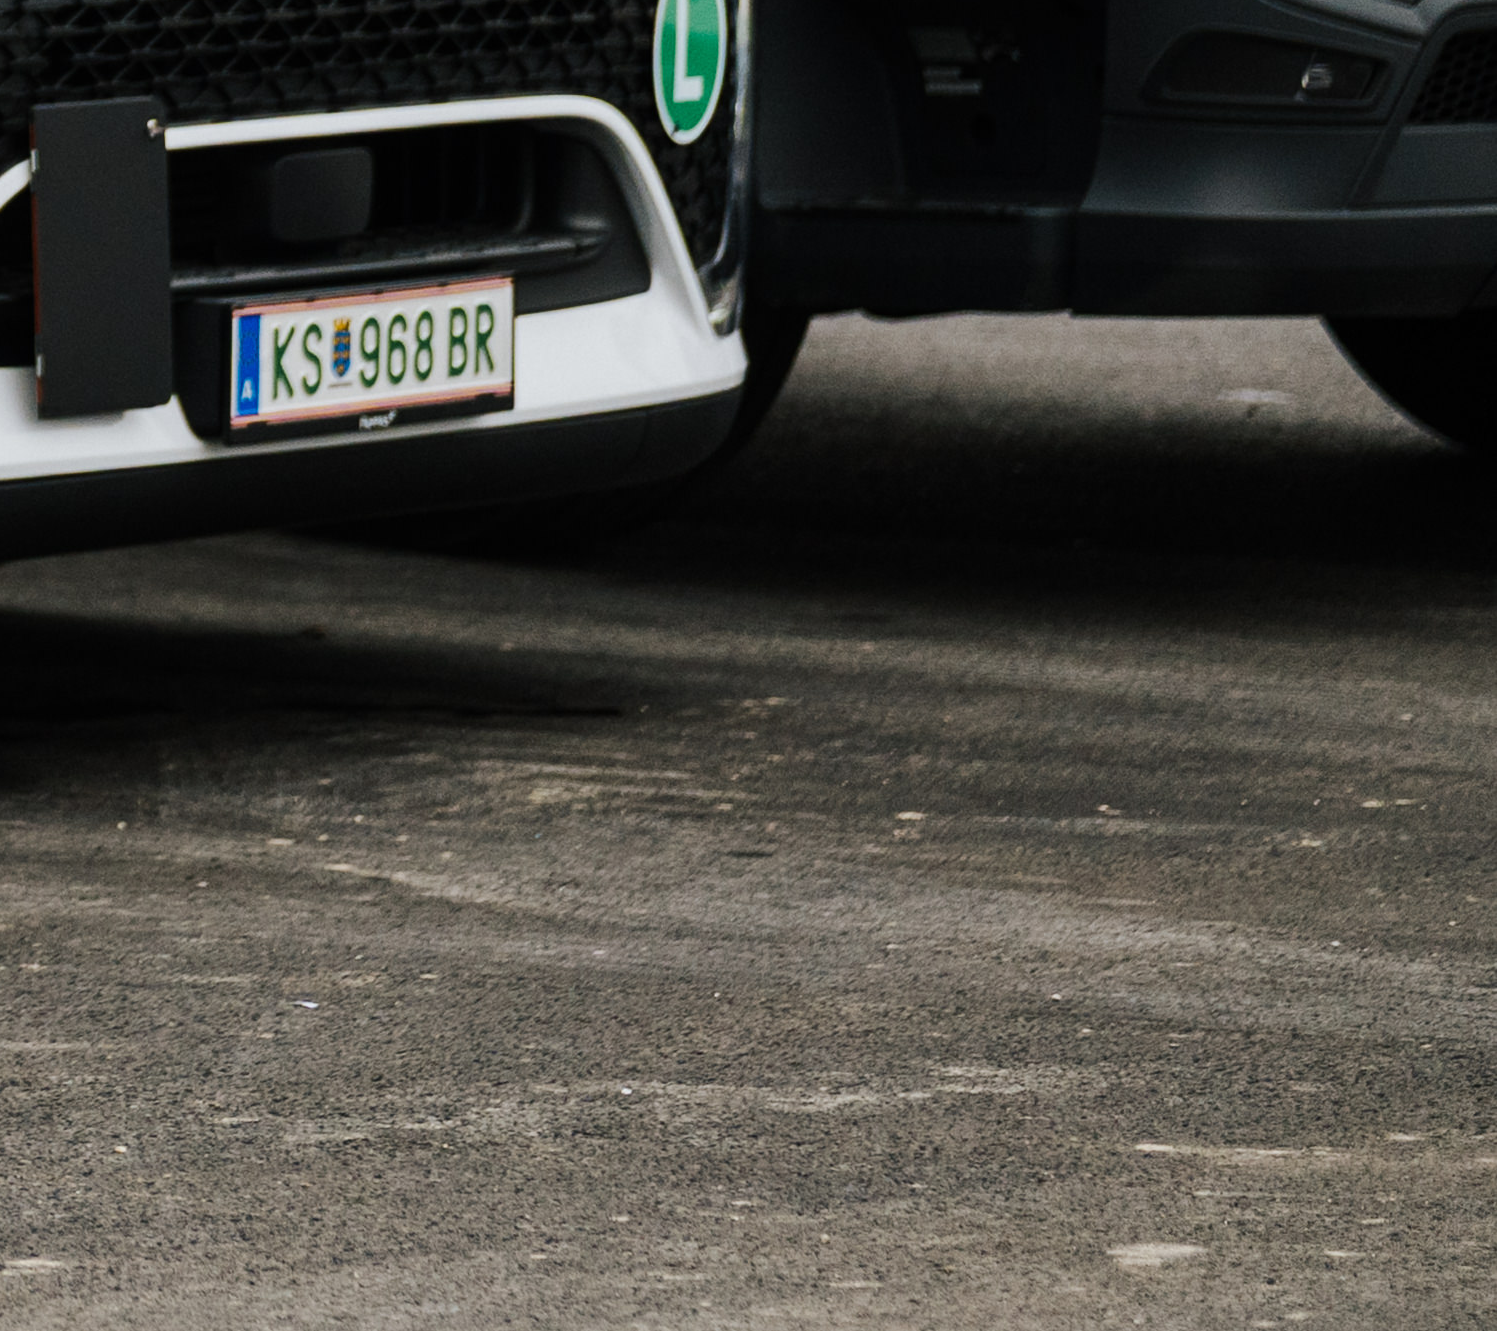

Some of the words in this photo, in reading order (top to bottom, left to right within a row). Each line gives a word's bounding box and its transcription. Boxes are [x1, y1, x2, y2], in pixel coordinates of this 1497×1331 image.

[272, 322, 323, 400] KS
[359, 310, 434, 388] 968
[448, 303, 495, 378] BR
